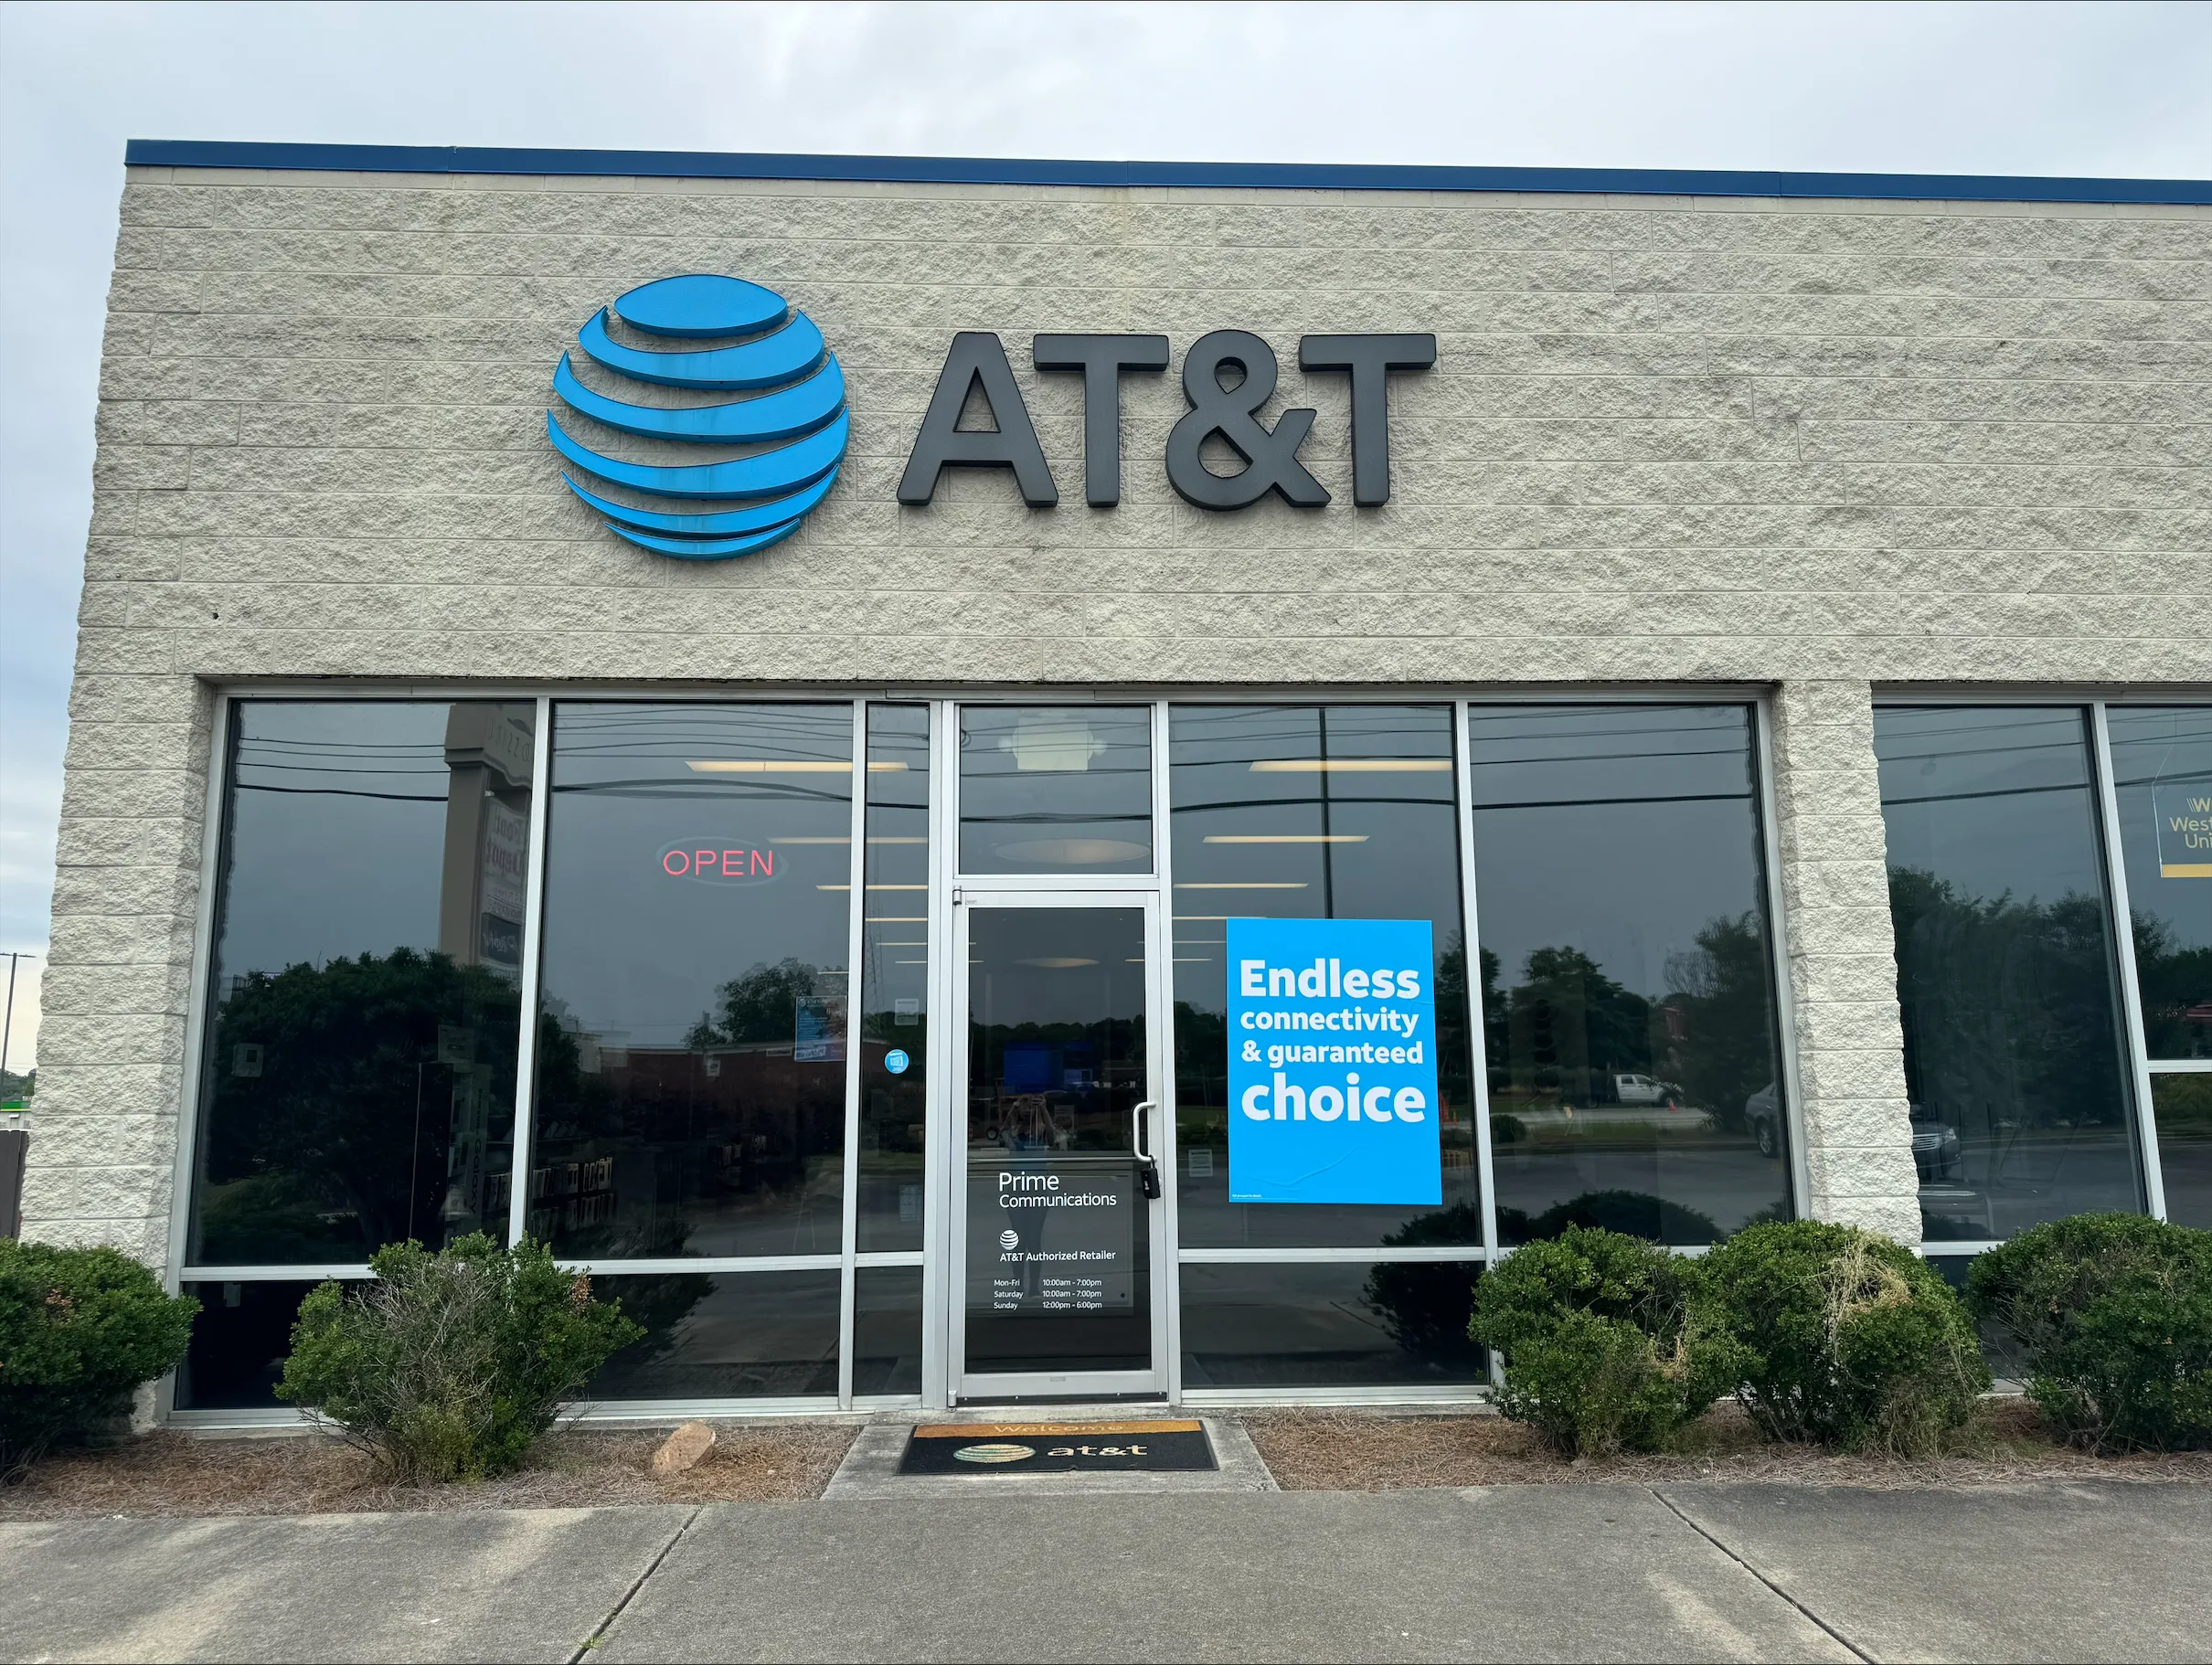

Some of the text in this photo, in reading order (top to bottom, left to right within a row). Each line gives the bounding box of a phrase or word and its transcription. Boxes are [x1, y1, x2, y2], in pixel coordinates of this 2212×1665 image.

[897, 329, 1437, 511] AT&T
[663, 850, 773, 876] OPEN
[1240, 958, 1420, 999] Endless
[1240, 1006, 1420, 1038] connectivity
[1241, 1040, 1423, 1068] & guaranteed
[1241, 1072, 1426, 1123] choice
[470, 1140, 482, 1214] Galaxy
[999, 1171, 1059, 1192] Prime
[999, 1193, 1117, 1208] Communications
[999, 1250, 1116, 1262] AT&T Authorized Retailer
[1077, 1279, 1102, 1288] 7:00pm
[994, 1290, 1023, 1299] Saturday
[1077, 1290, 1102, 1299] 7:00pm
[994, 1301, 1018, 1310] Sunday
[1042, 1301, 1071, 1310] 12:00pm
[1077, 1301, 1102, 1310] 6:00pm
[994, 1423, 1123, 1434] Welcome
[1047, 1445, 1148, 1458] at&t
